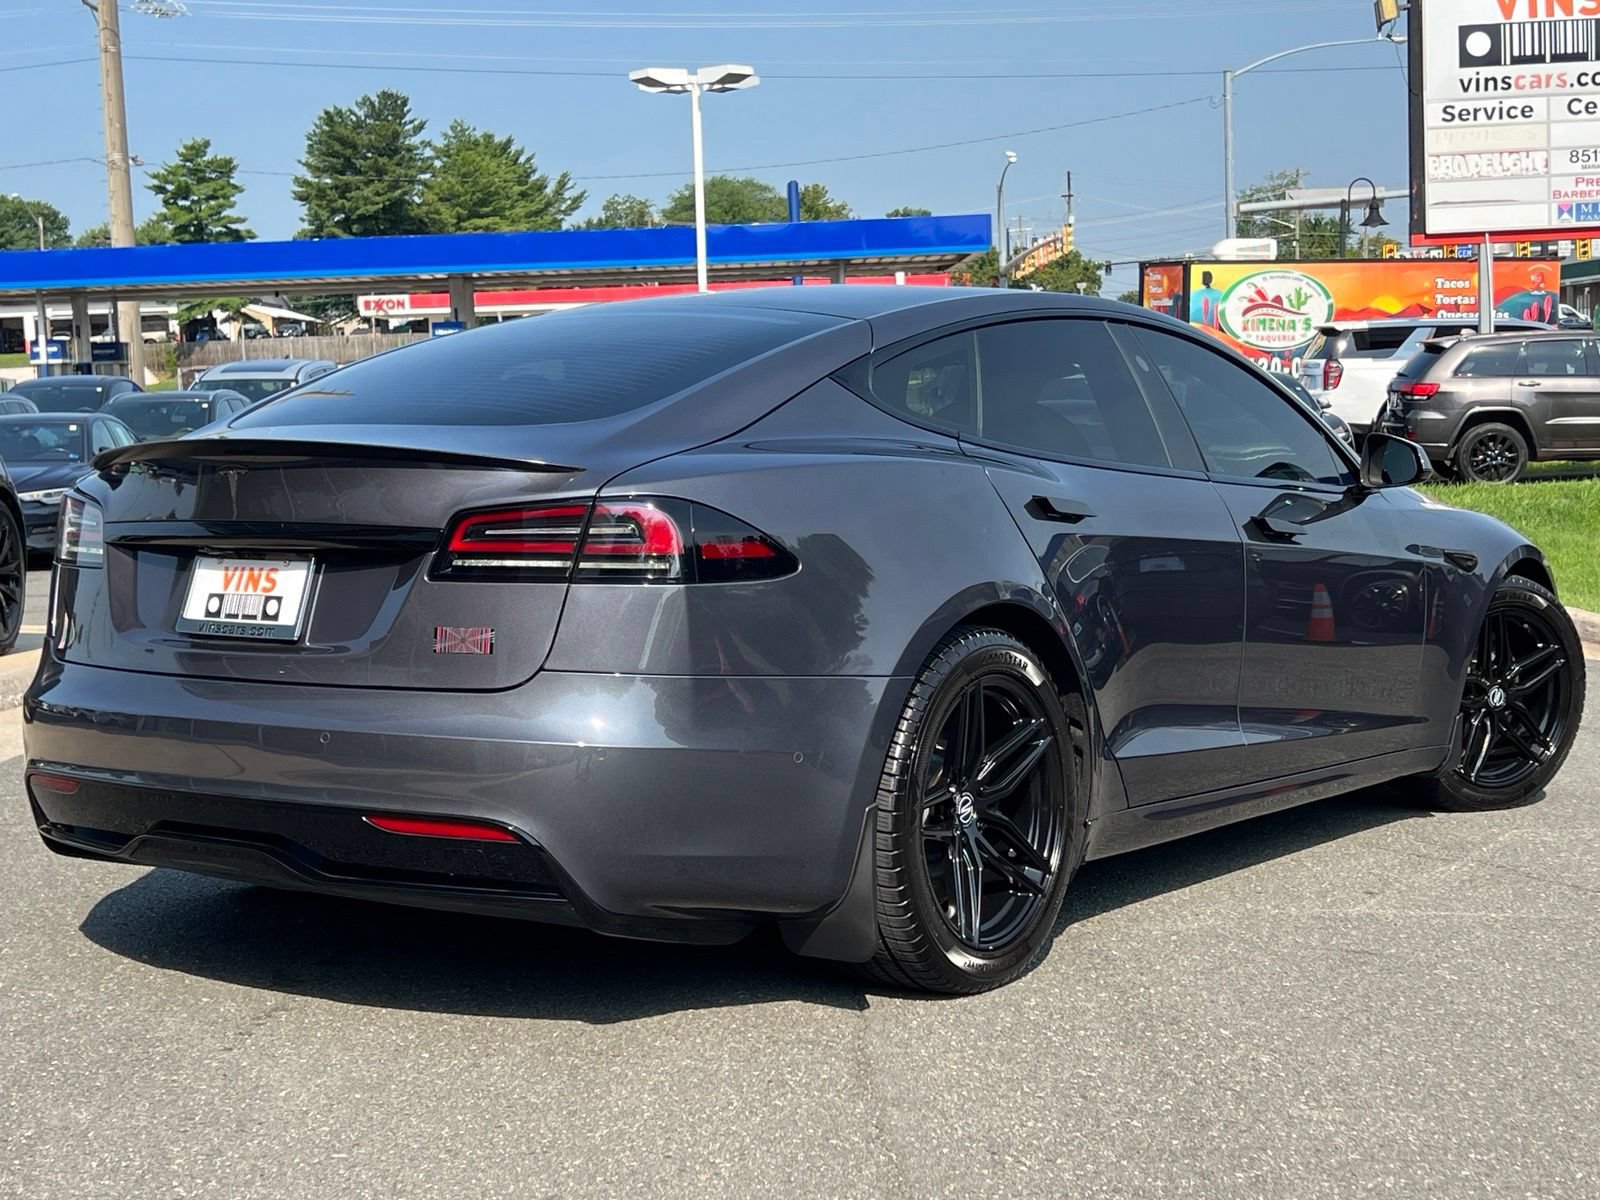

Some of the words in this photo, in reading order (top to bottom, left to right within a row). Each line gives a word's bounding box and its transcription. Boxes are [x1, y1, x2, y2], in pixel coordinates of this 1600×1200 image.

[1441, 101, 1534, 123] Service
[1569, 149, 1600, 164] 851
[1435, 278, 1470, 289] Tacos
[363, 298, 405, 313] EXXON
[1435, 294, 1475, 306] Tortas
[1242, 317, 1312, 332] XIMENA'S
[1256, 334, 1296, 343] TAQUERIA
[223, 567, 279, 592] VINS
[200, 623, 275, 636] vinscars.com
